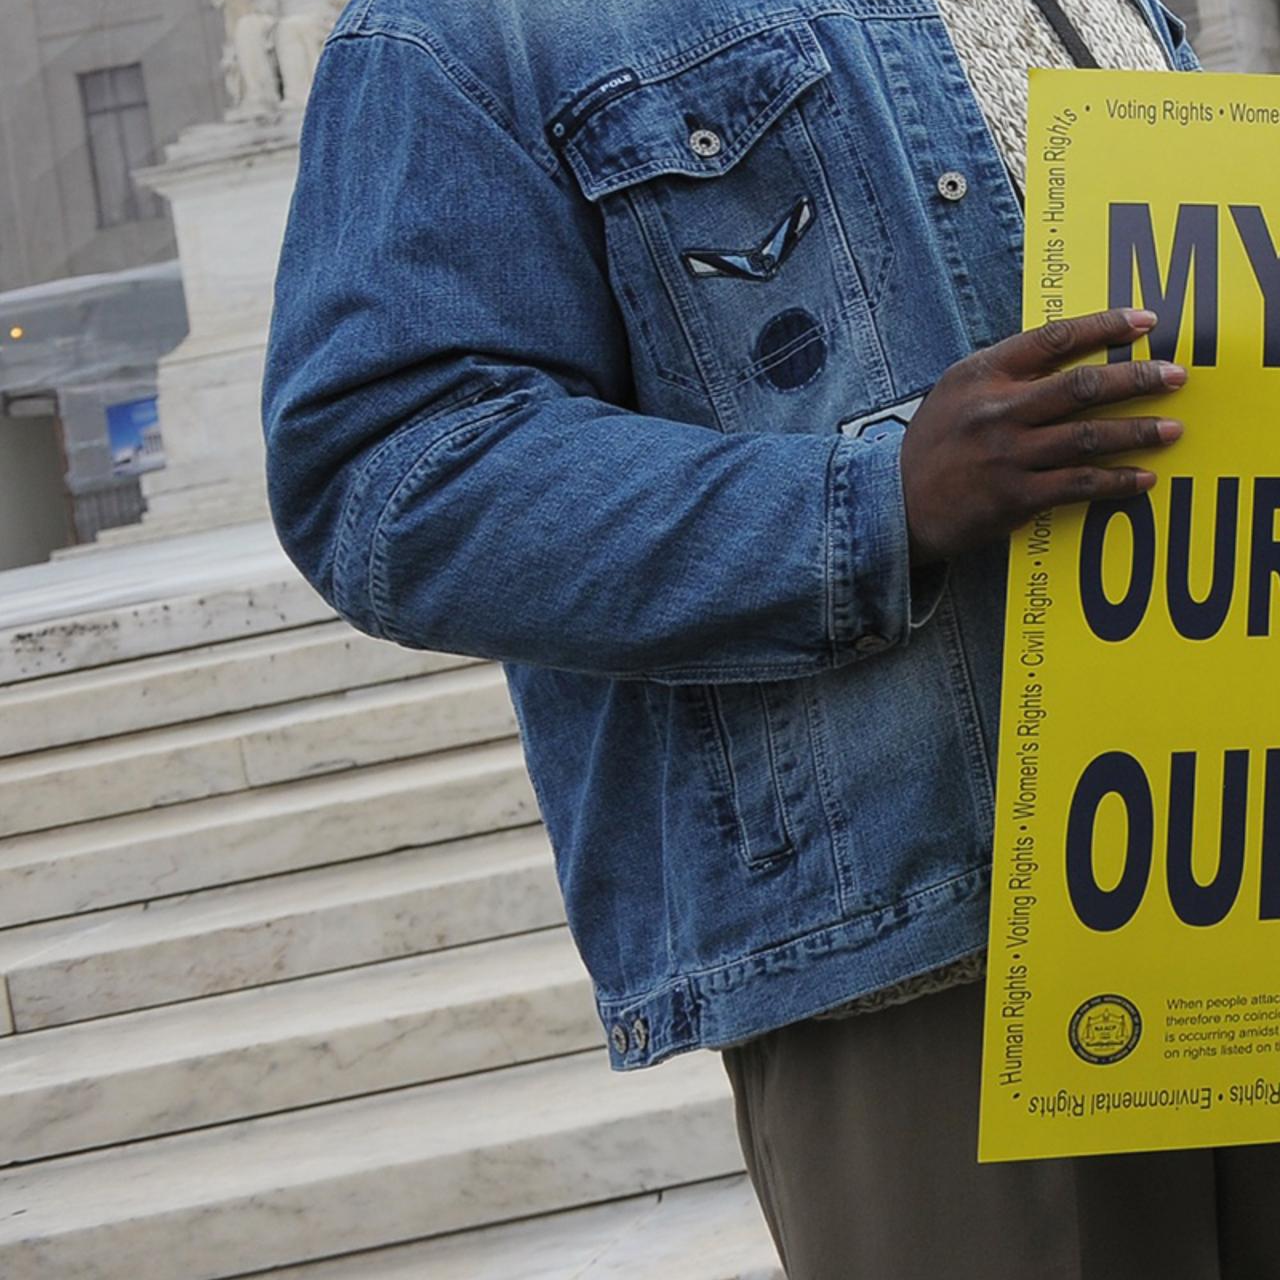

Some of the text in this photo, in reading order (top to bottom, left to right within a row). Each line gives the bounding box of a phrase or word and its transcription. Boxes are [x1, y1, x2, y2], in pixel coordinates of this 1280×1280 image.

[1043, 108, 1078, 162] Rights
[1105, 99, 1157, 125] Voting
[1162, 100, 1213, 126] Rights
[1042, 167, 1066, 222] Human
[1041, 238, 1070, 289] Rights
[1022, 571, 1053, 625] Rights
[1020, 630, 1045, 666] Civil
[1016, 683, 1047, 737] Rights
[1012, 742, 1039, 820] Women's
[1008, 836, 1039, 890] Rights
[1005, 895, 1037, 949] Voting
[1001, 965, 1032, 1018] Rights
[1164, 1032, 1176, 1043] is
[1178, 1028, 1236, 1042] occurring
[1238, 1025, 1279, 1039] amidst
[1165, 1013, 1221, 1027] therefore
[1223, 1013, 1241, 1023] no
[999, 1023, 1024, 1086] Human
[1163, 1049, 1180, 1059] on
[1183, 1045, 1217, 1059] rights
[1220, 1042, 1253, 1055] listed
[1255, 1043, 1272, 1054] on
[1028, 1089, 1085, 1118] Rights
[1090, 1087, 1212, 1115] Environmental
